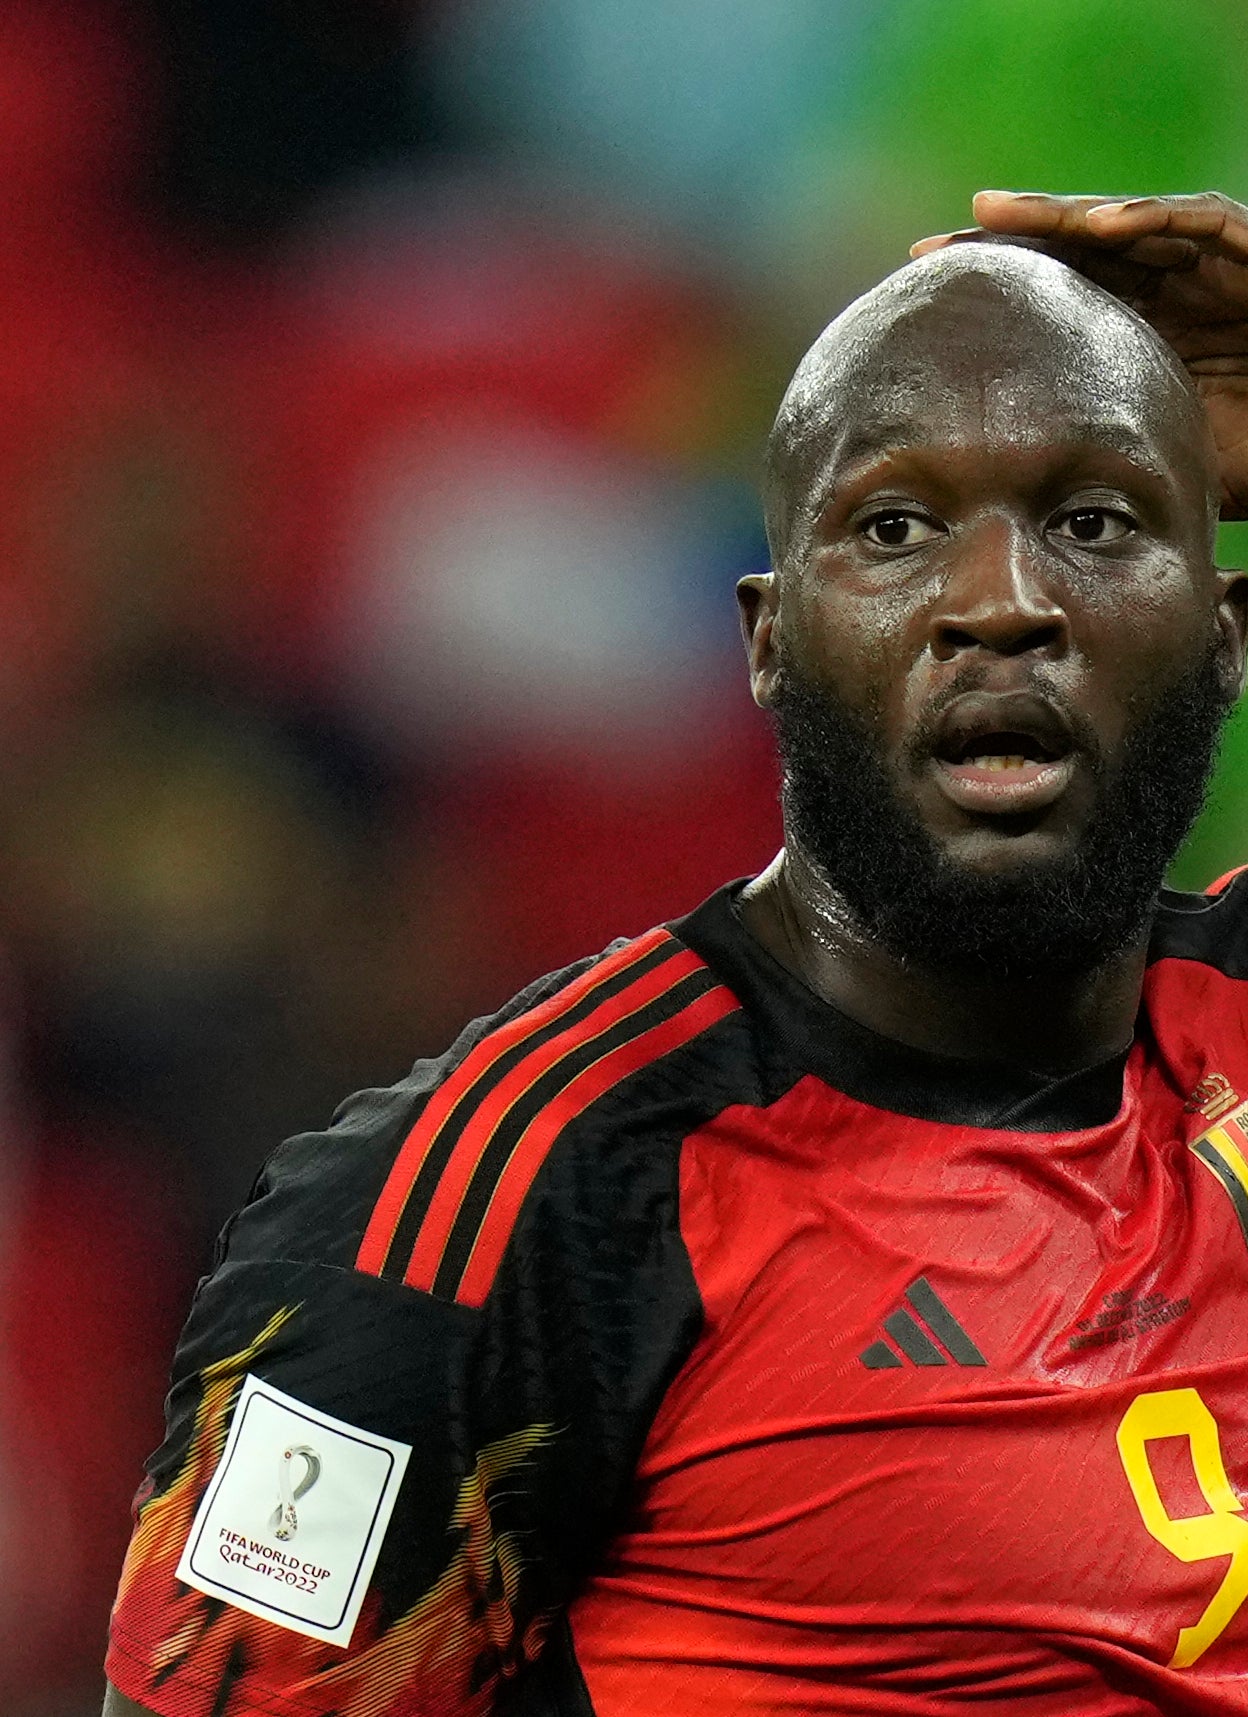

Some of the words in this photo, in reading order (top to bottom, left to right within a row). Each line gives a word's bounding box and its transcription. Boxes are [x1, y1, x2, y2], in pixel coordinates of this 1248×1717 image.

[219, 1528, 247, 1549] FIFA
[249, 1541, 300, 1569] WORLD
[302, 1563, 331, 1580] CUP
